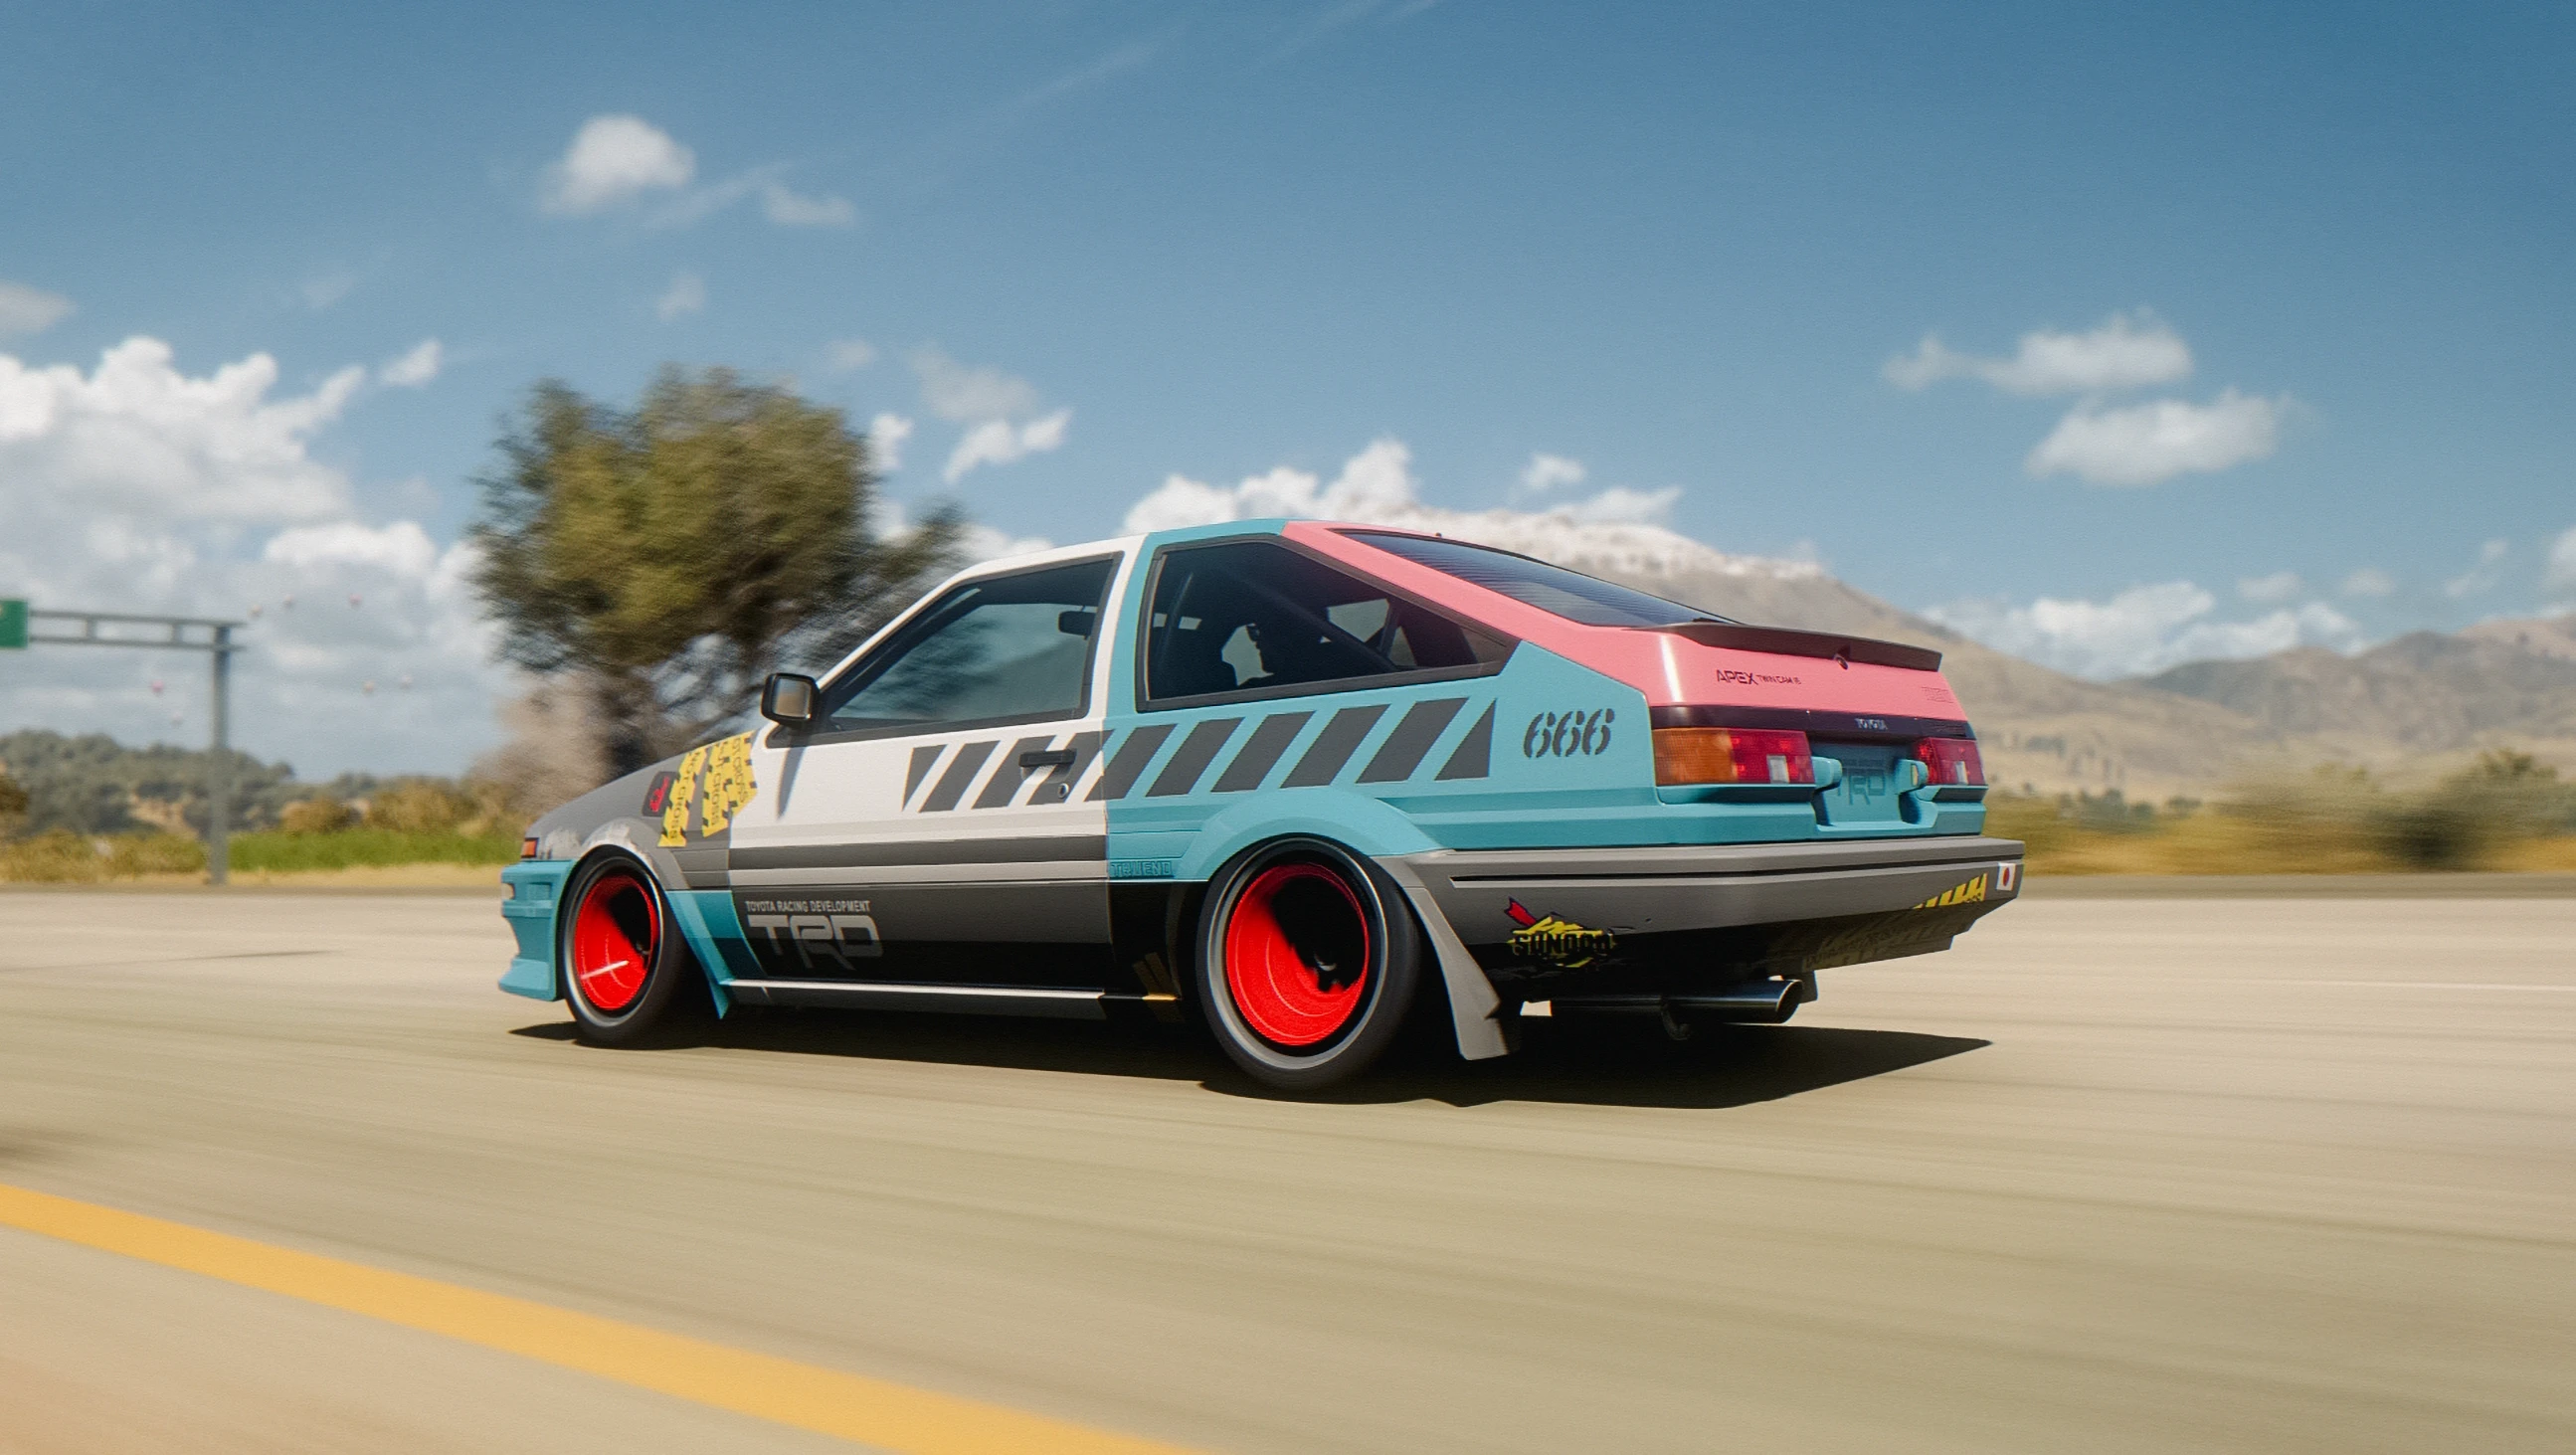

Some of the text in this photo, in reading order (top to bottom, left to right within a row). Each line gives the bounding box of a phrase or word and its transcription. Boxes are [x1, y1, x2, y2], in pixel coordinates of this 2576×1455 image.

[1716, 669, 1758, 686] APEX
[1755, 674, 1776, 684] TWIN
[1523, 708, 1615, 758] 666
[670, 784, 687, 839] CROSS
[710, 773, 722, 826] CROSS
[745, 900, 871, 913] TOYOTA RACING DEVELOPMENT
[747, 914, 884, 971] TRD
